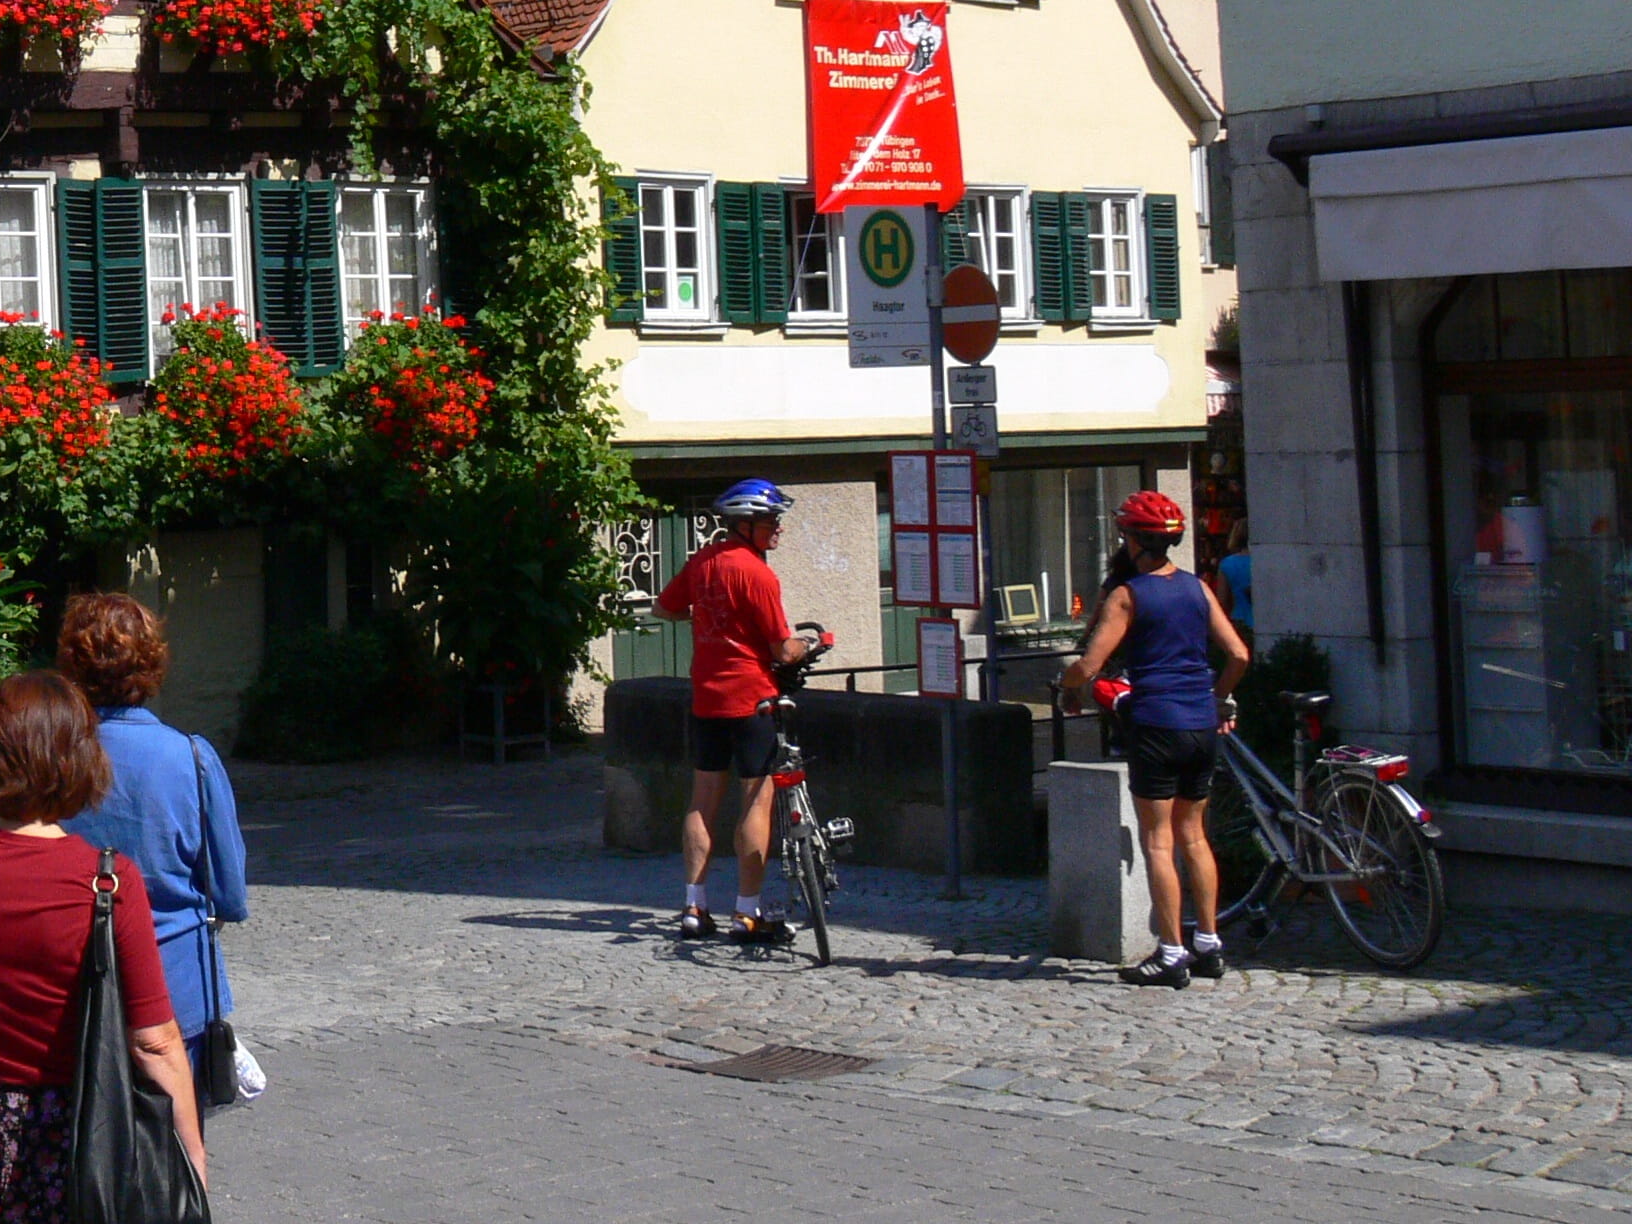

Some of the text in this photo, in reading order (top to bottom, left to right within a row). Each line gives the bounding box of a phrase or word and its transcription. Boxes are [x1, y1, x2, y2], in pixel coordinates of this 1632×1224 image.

[828, 70, 899, 90] Zimmerei
[873, 227, 900, 270] H
[872, 301, 905, 314] Haagtor
